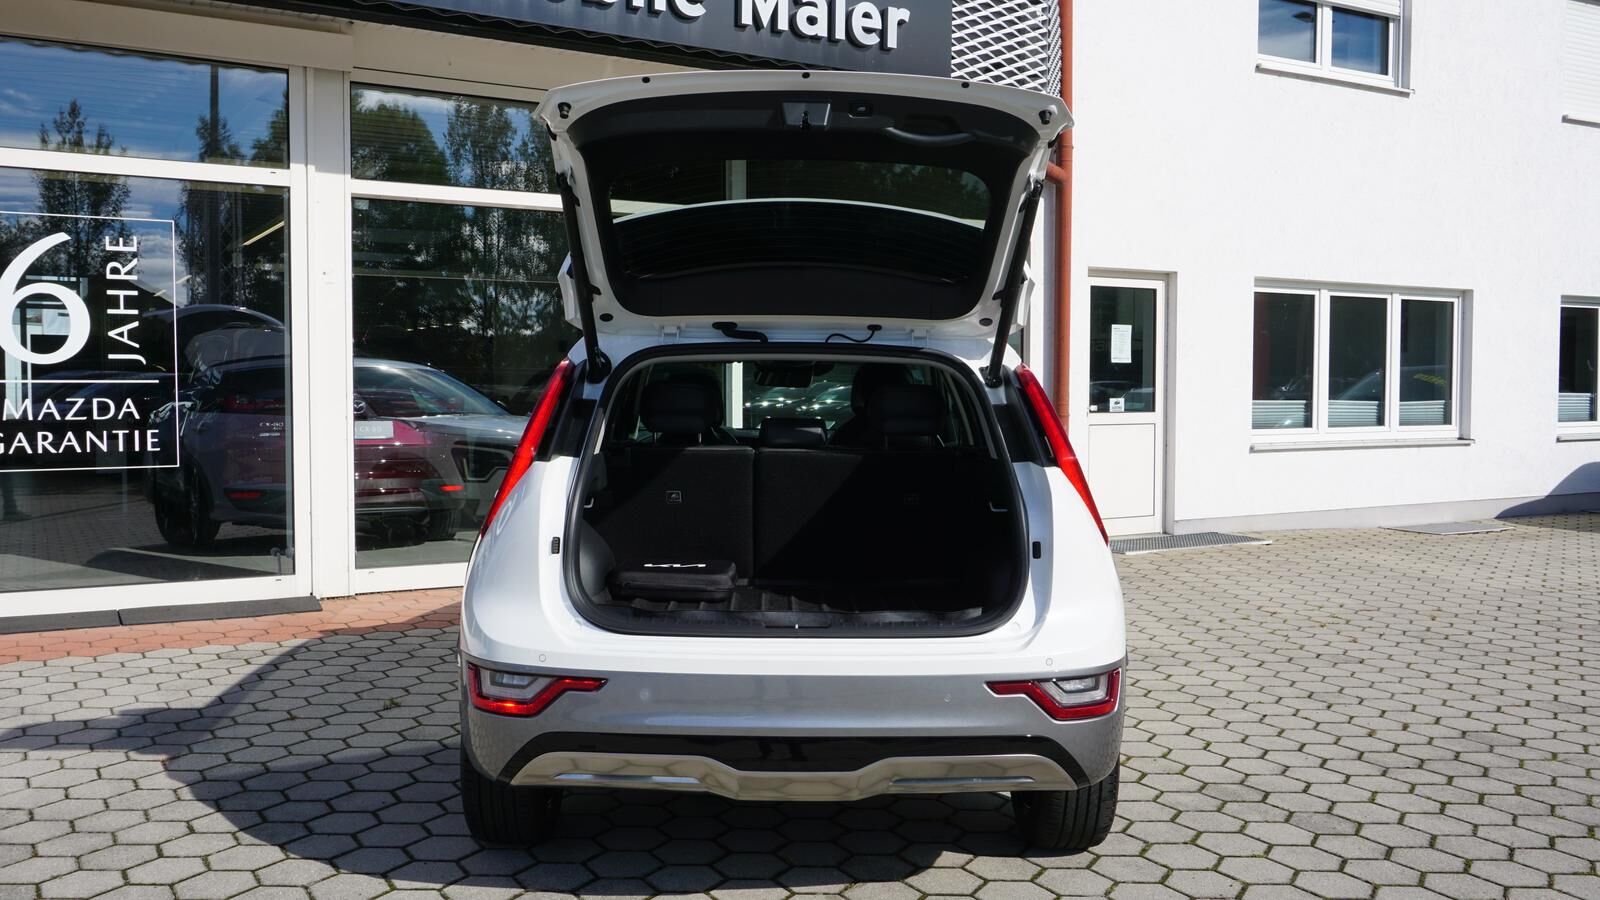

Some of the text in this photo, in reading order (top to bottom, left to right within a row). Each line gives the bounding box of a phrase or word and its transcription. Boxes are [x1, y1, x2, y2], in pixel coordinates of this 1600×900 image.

[0, 232, 91, 365] 6
[105, 235, 146, 365] JAHRE
[0, 429, 161, 455] ARANTIE
[2, 398, 140, 421] MAZDA
